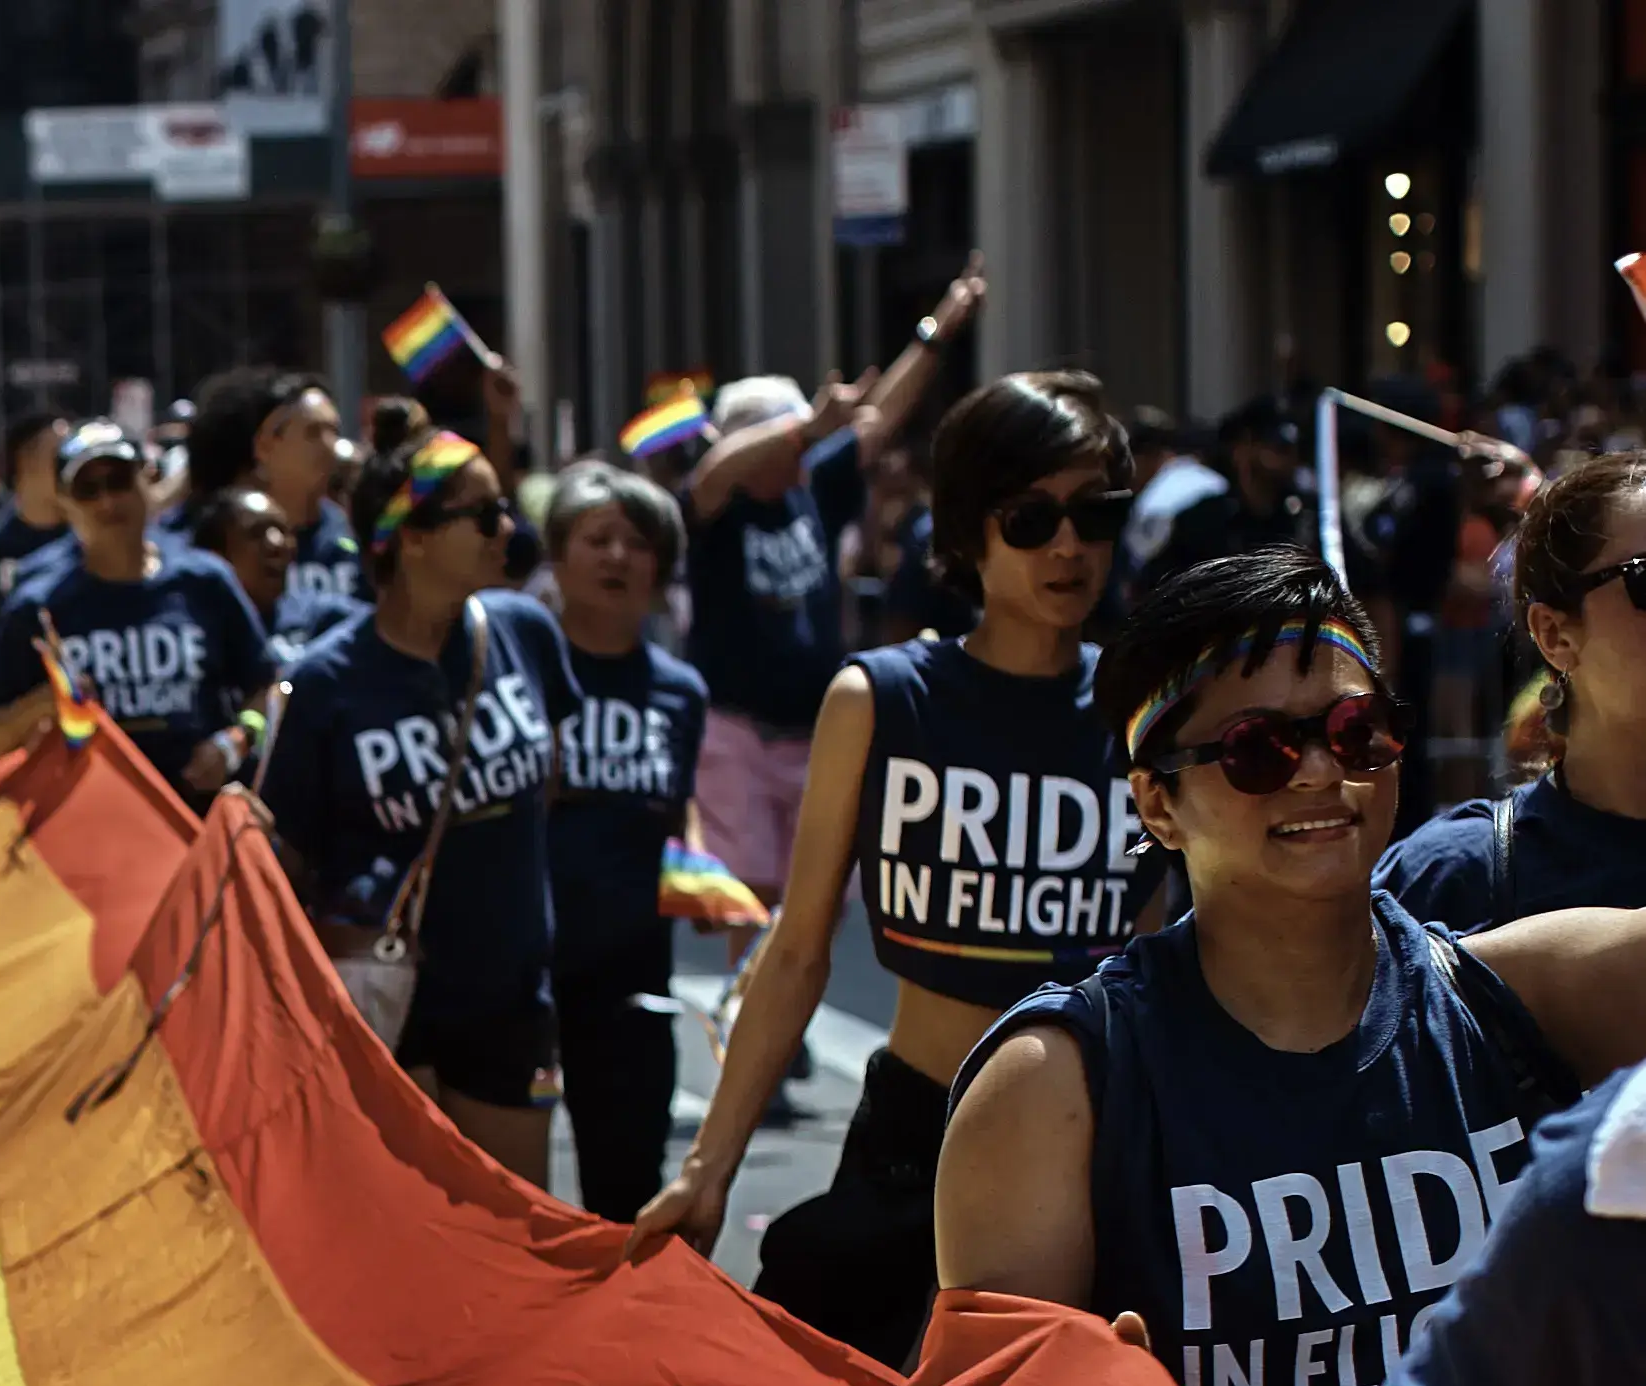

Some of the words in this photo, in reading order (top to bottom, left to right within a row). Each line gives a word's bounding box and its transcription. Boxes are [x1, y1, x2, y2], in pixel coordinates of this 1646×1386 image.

[61, 624, 207, 685] PRIDE
[566, 753, 673, 795] LIGHT
[372, 791, 422, 832] IN
[881, 756, 1144, 874] PRIDE
[878, 858, 932, 925] IN
[946, 868, 1136, 937] FLIGHT.
[1170, 1117, 1525, 1331] PRIDE
